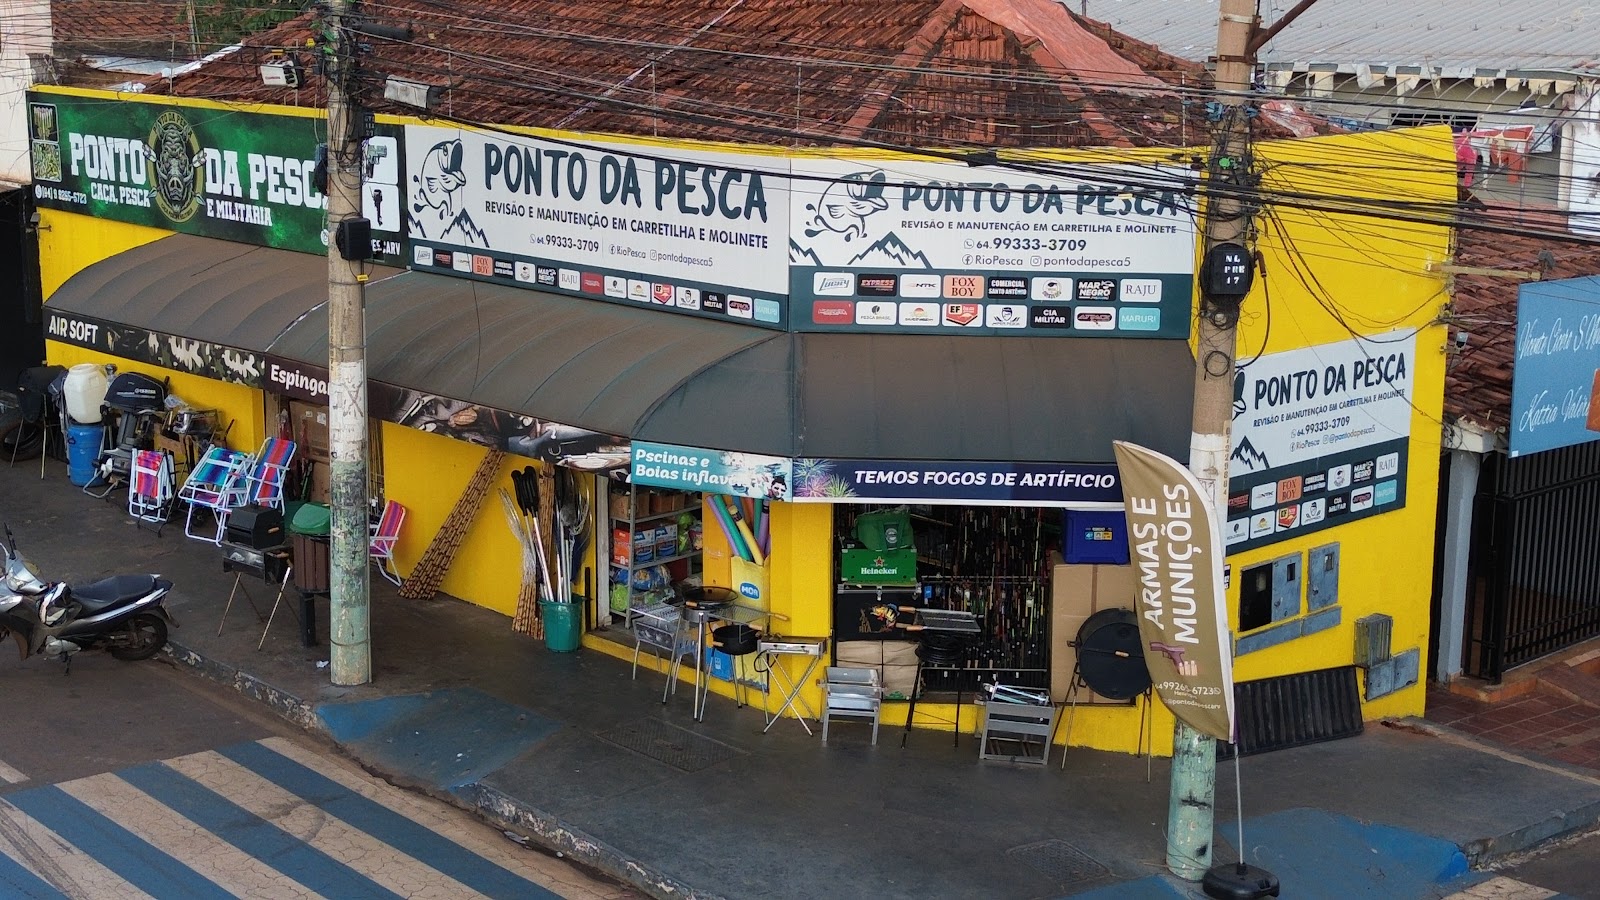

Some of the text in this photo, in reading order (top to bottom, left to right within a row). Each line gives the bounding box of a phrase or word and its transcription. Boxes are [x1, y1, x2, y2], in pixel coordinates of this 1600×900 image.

[69, 132, 328, 210] PONTO DA PESC
[484, 142, 768, 223] PONTO DA PESCA
[119, 185, 151, 208] PESCA
[902, 181, 1177, 216] PONTO DA PESCA
[206, 198, 215, 217] E
[215, 200, 273, 227] MILITARIA
[485, 200, 768, 249] REVISÃO E MANUTENÇÃO EM CARRETILHA E MOLINETE
[901, 218, 1177, 234] REVISÃO E MANUTENÇÃO EM CARRETILHA E MOLINETE
[616, 245, 713, 267] RioPesca pontodapesca5
[975, 255, 1131, 268] RioPesca pontodapesca5
[561, 274, 578, 284] RAJU
[951, 277, 976, 287] FOX
[990, 279, 1025, 288] COMERCIAL
[1078, 281, 1101, 289] MAR
[1226, 276, 1240, 284] 17
[951, 287, 976, 297] BOY
[1079, 288, 1111, 297] NEGRO
[1125, 284, 1157, 297] RAJU
[703, 300, 723, 310] MILITAR
[949, 305, 961, 314] EF
[1034, 316, 1066, 324] MILITAR
[1121, 315, 1156, 323] MARURI
[49, 315, 98, 344] AIR SOFT
[1254, 352, 1406, 410] PONTO DA PESCA
[1253, 414, 1280, 428] REVISÃO
[1285, 405, 1328, 421] MANUTENÇÃO
[1329, 402, 1338, 411] EM
[1338, 394, 1373, 410] CARRETILHA
[1373, 393, 1377, 402] E
[1377, 388, 1405, 401] MOLINETE
[1296, 439, 1320, 450] RioPesca
[635, 449, 710, 468] Pscinas e
[1379, 457, 1397, 471] RAJU
[635, 464, 679, 481] Boias
[854, 470, 1116, 489] TEMOS FOGOS DE ARTÍFICIO
[1282, 479, 1297, 491] FOX
[1282, 489, 1297, 501] BOY
[1131, 497, 1165, 631] ARMAS E
[1160, 483, 1203, 644] MUNIÇÕES
[860, 567, 898, 575] Heineken
